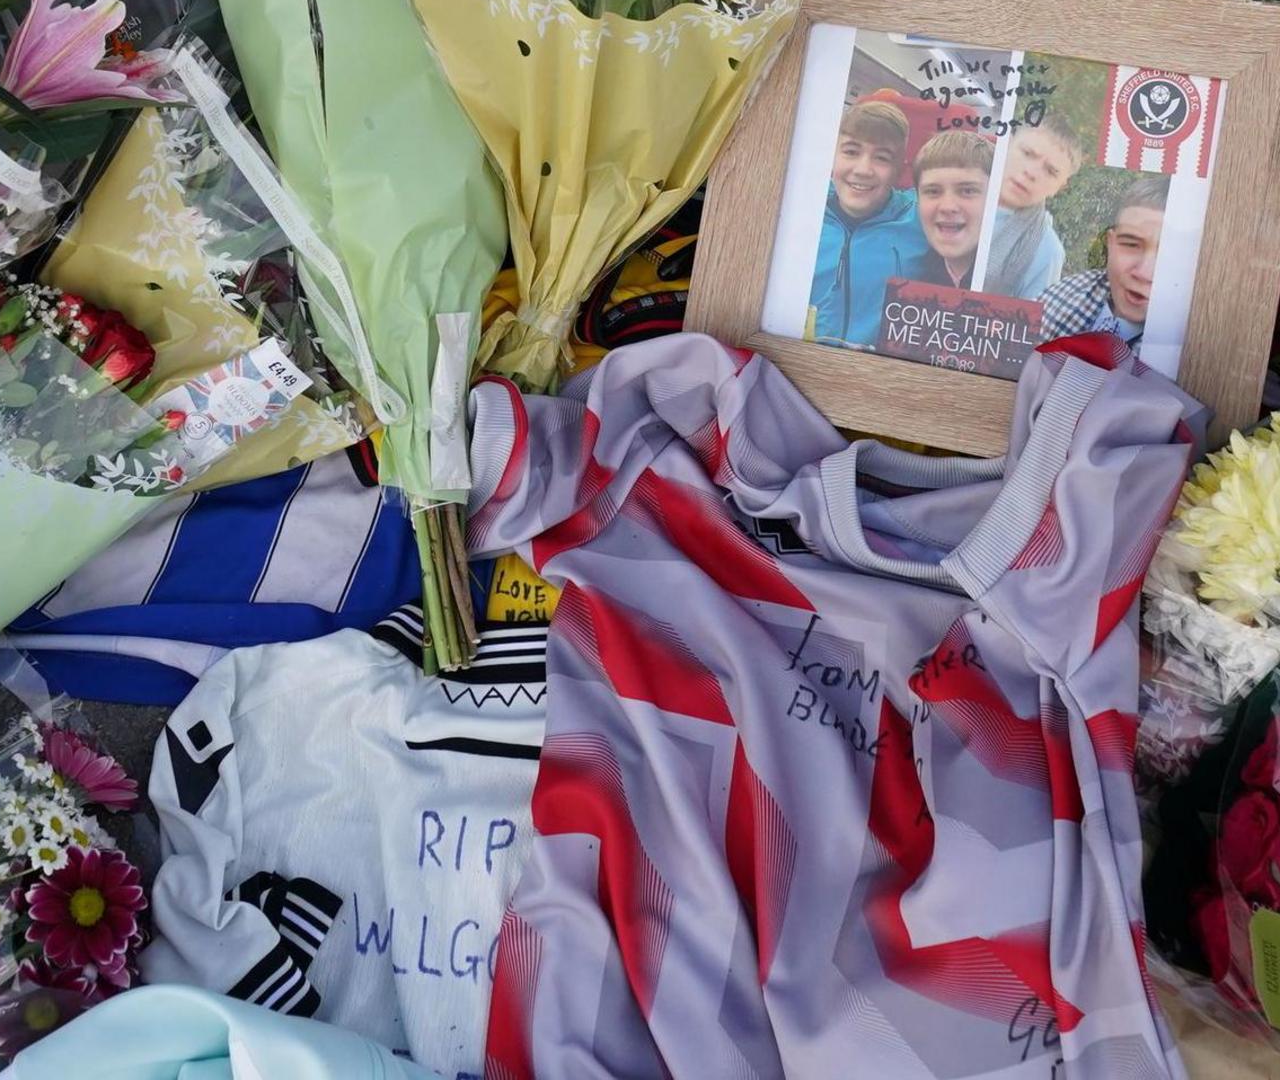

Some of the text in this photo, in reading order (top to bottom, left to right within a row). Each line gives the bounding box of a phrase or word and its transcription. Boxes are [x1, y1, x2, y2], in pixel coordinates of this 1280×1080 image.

[918, 58, 955, 81] Till
[1118, 69, 1161, 104] SHEFFIELD
[885, 302, 1033, 345] COME THRILL
[887, 322, 922, 346] ME
[925, 330, 1001, 359] AGAIN
[268, 361, 298, 388] £4.49
[495, 570, 546, 605] LOVE
[418, 810, 516, 871] RIP
